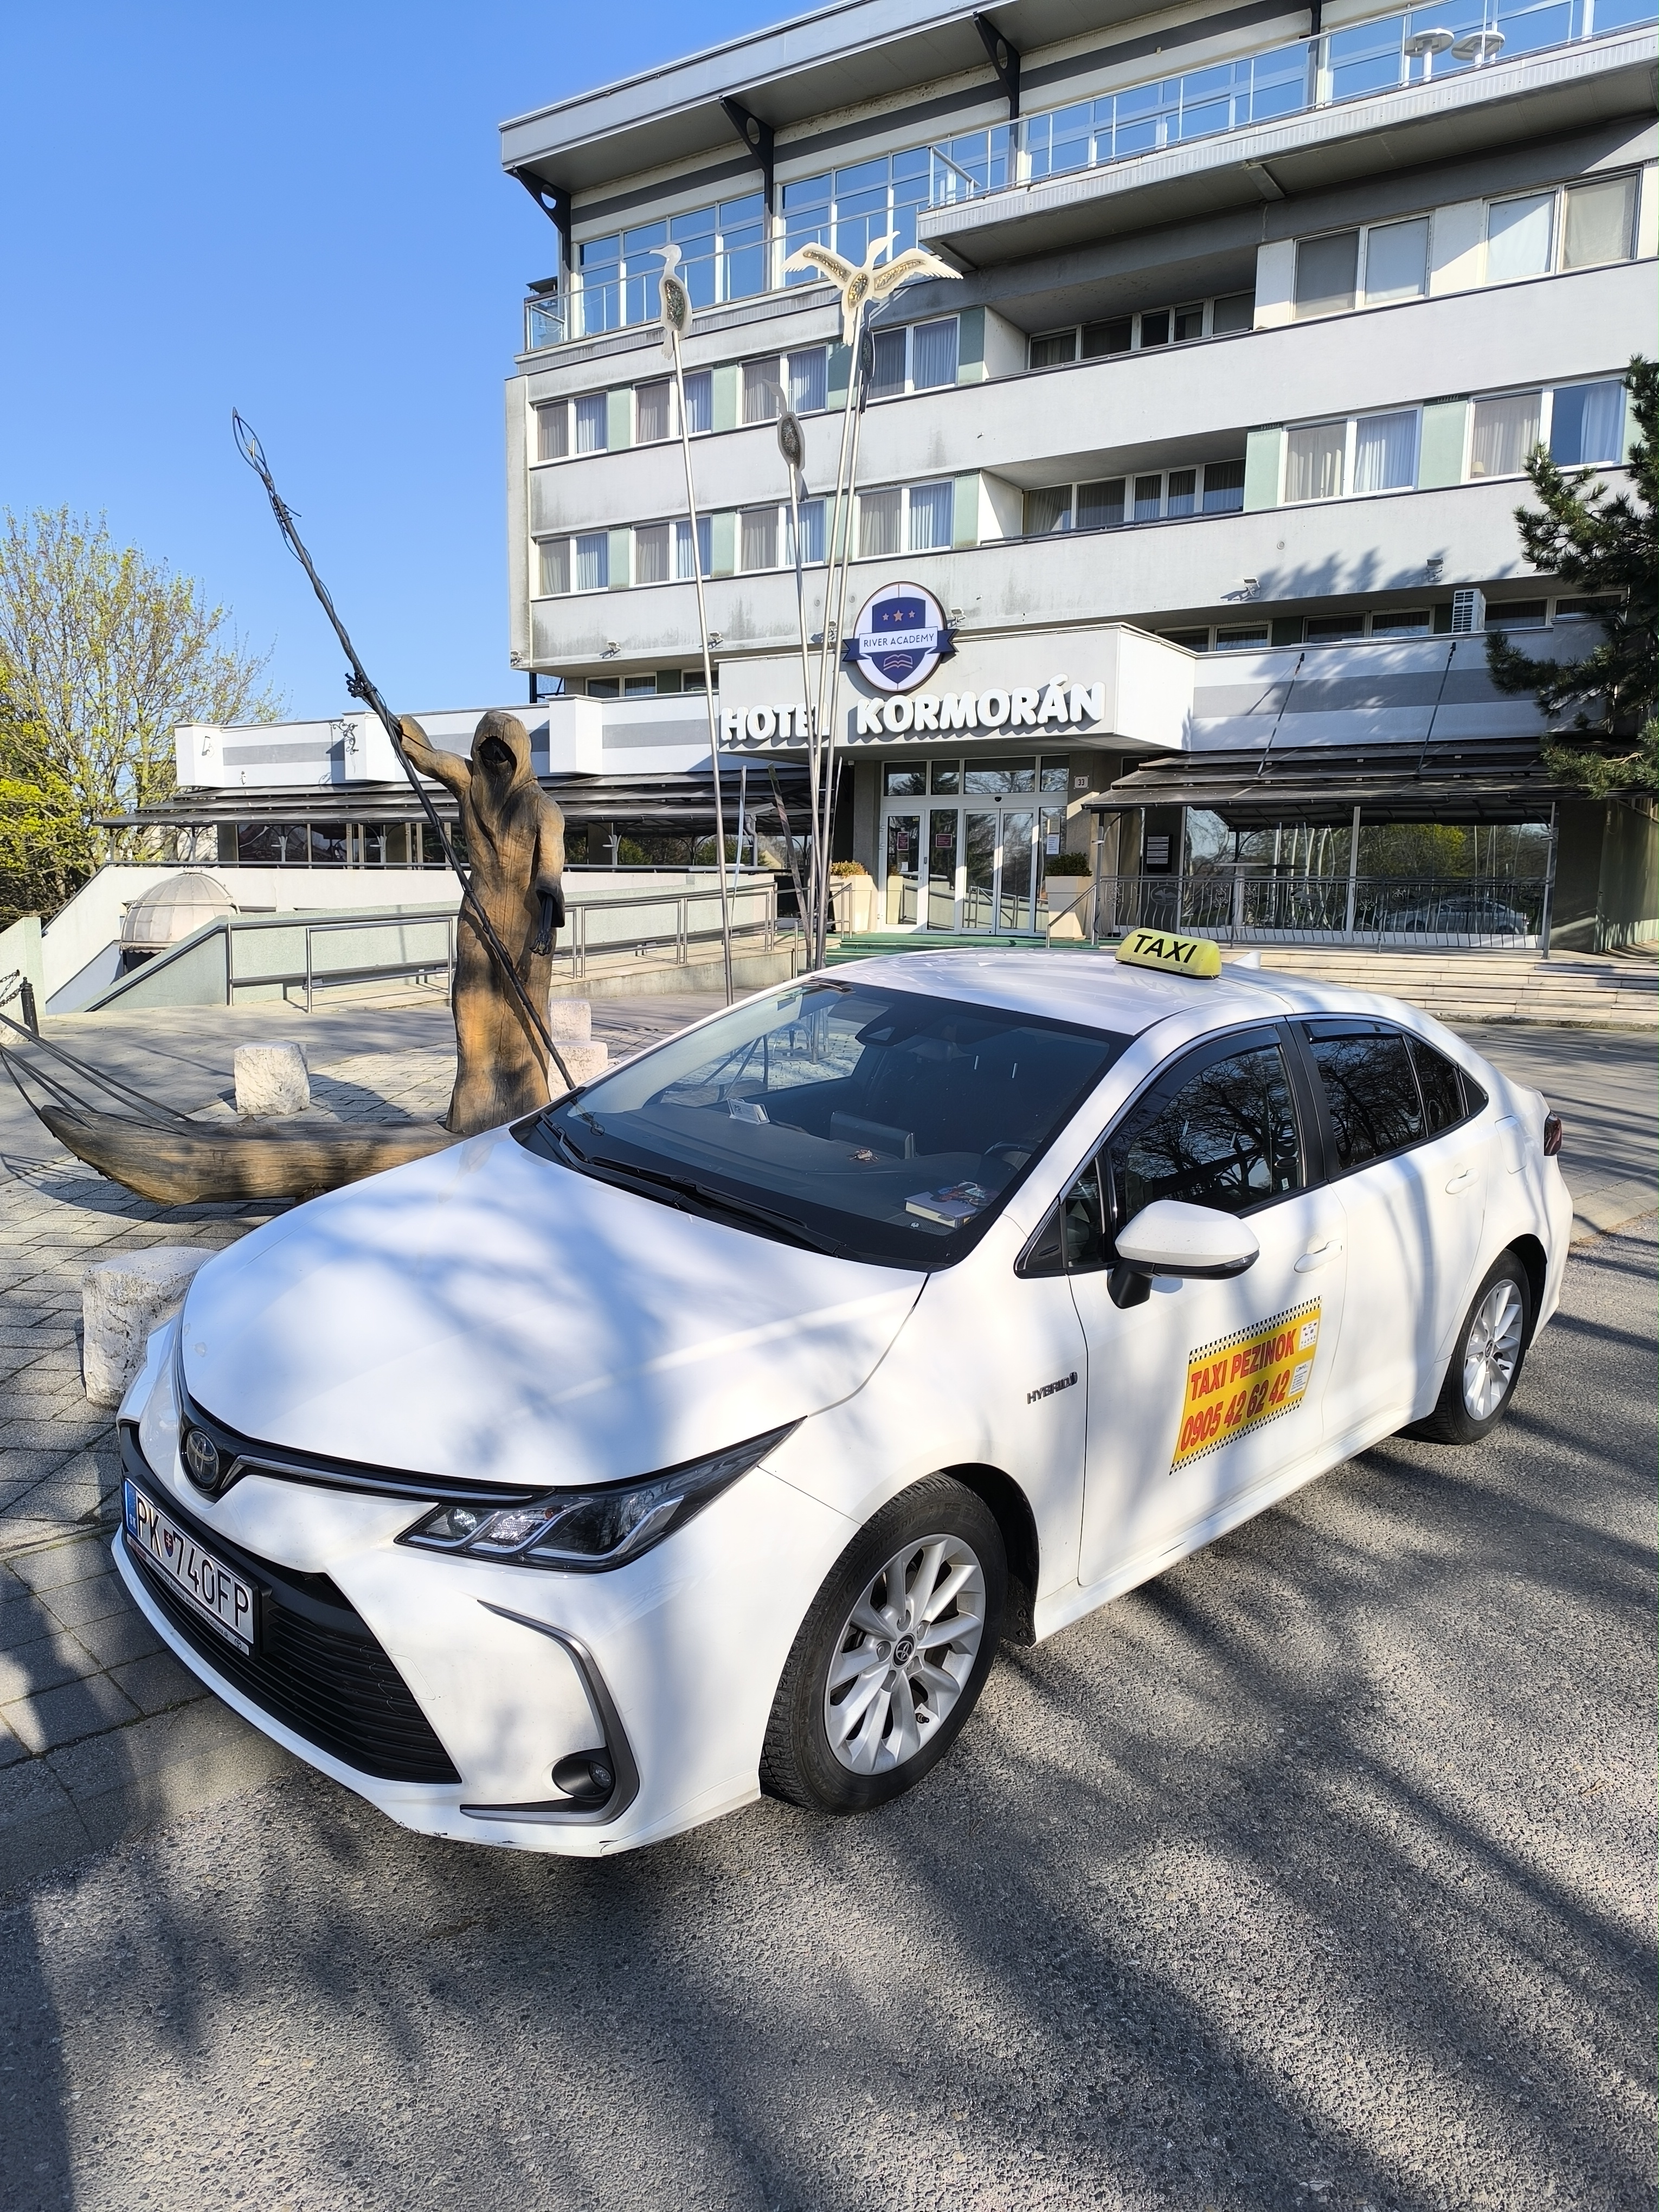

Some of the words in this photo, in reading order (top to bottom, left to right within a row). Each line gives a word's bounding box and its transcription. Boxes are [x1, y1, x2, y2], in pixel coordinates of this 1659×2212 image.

[864, 638, 888, 647] RIVER
[891, 633, 934, 645] ACADEMY
[857, 673, 1106, 735] KORMORÁN
[1134, 934, 1198, 963] TAXI
[1027, 1377, 1070, 1404] HYBRID
[1191, 1359, 1227, 1400] TAXI
[1230, 1328, 1297, 1383] PEZINOK
[1180, 1401, 1224, 1451] 0905
[1224, 1390, 1247, 1429] 42
[1246, 1379, 1269, 1418] 62
[1268, 1369, 1290, 1406] 42
[137, 1494, 162, 1559] PK
[173, 1528, 251, 1628] 740FP
